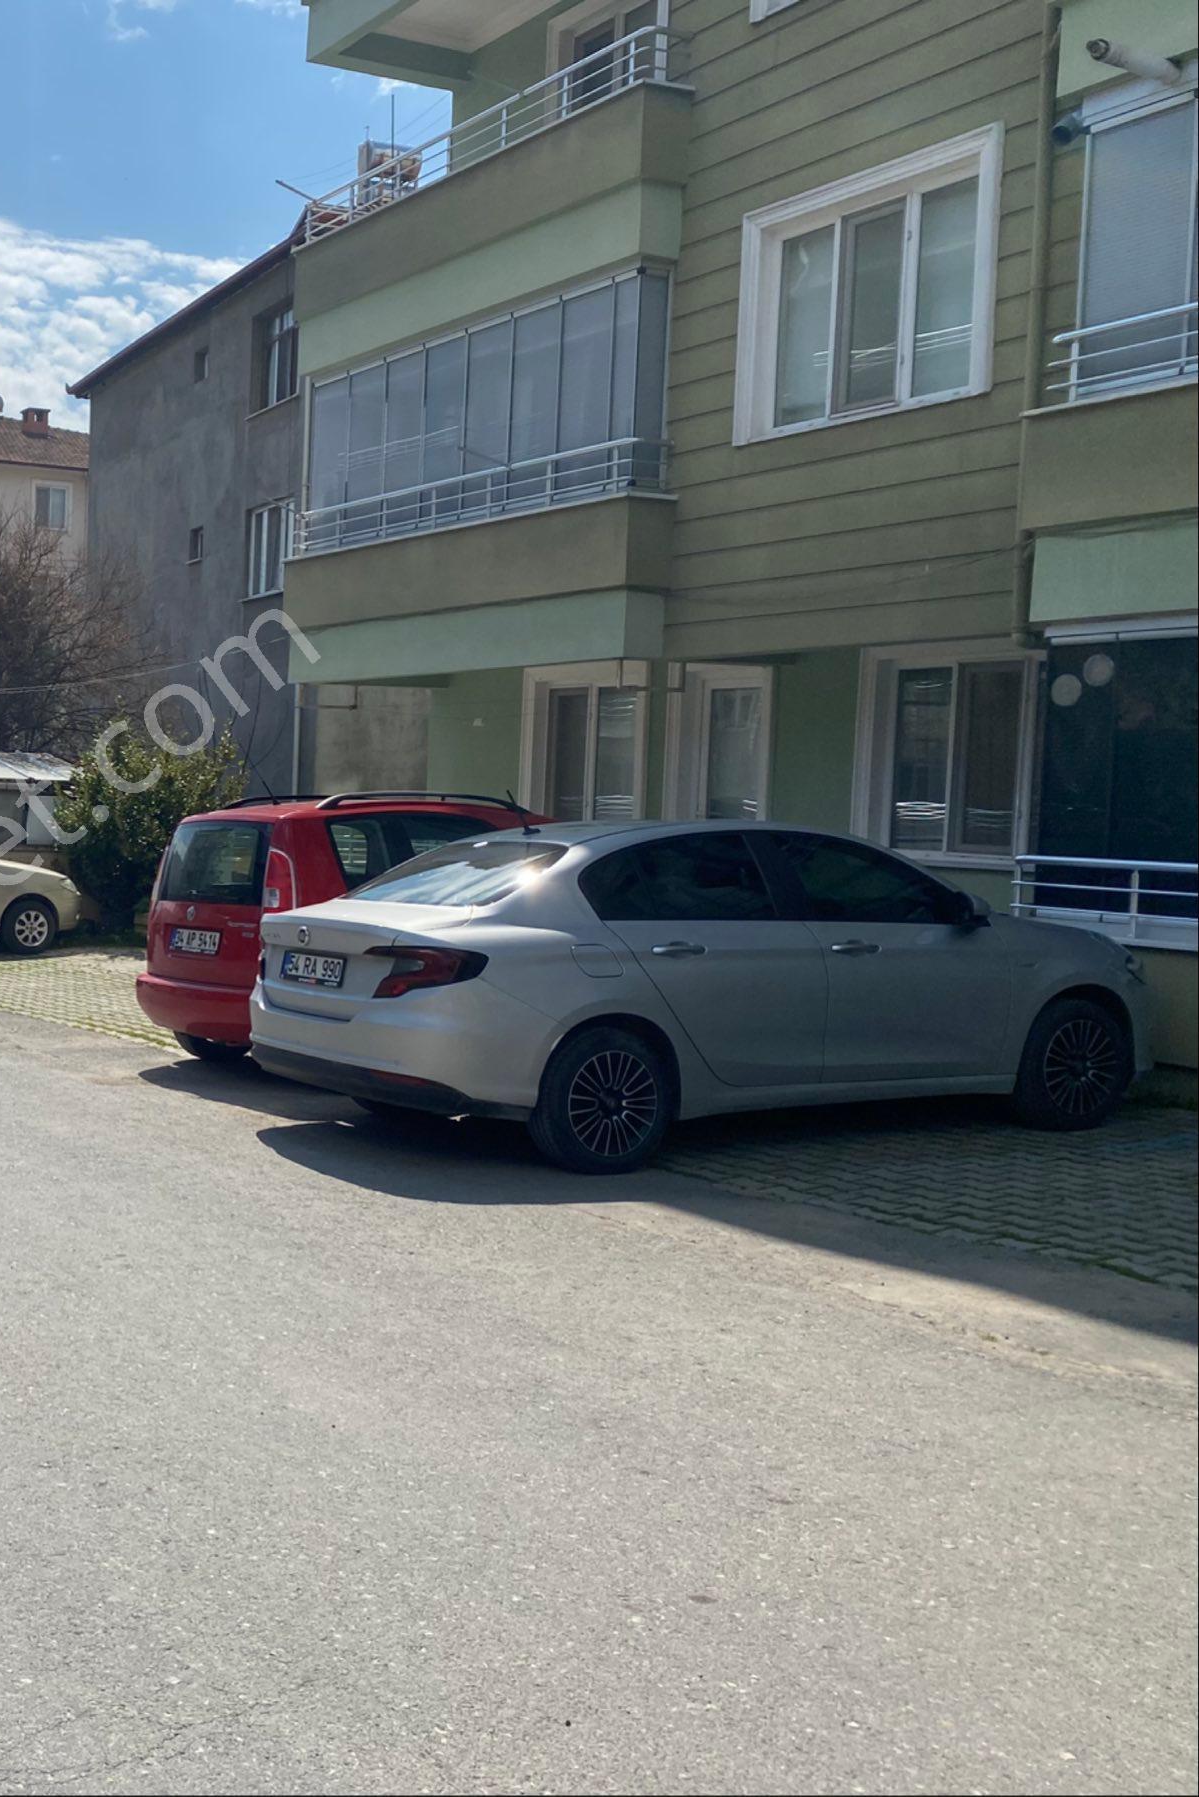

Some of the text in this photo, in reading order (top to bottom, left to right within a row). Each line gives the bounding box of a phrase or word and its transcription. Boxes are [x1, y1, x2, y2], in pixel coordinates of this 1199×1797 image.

[288, 954, 342, 979] 54 RA 990
